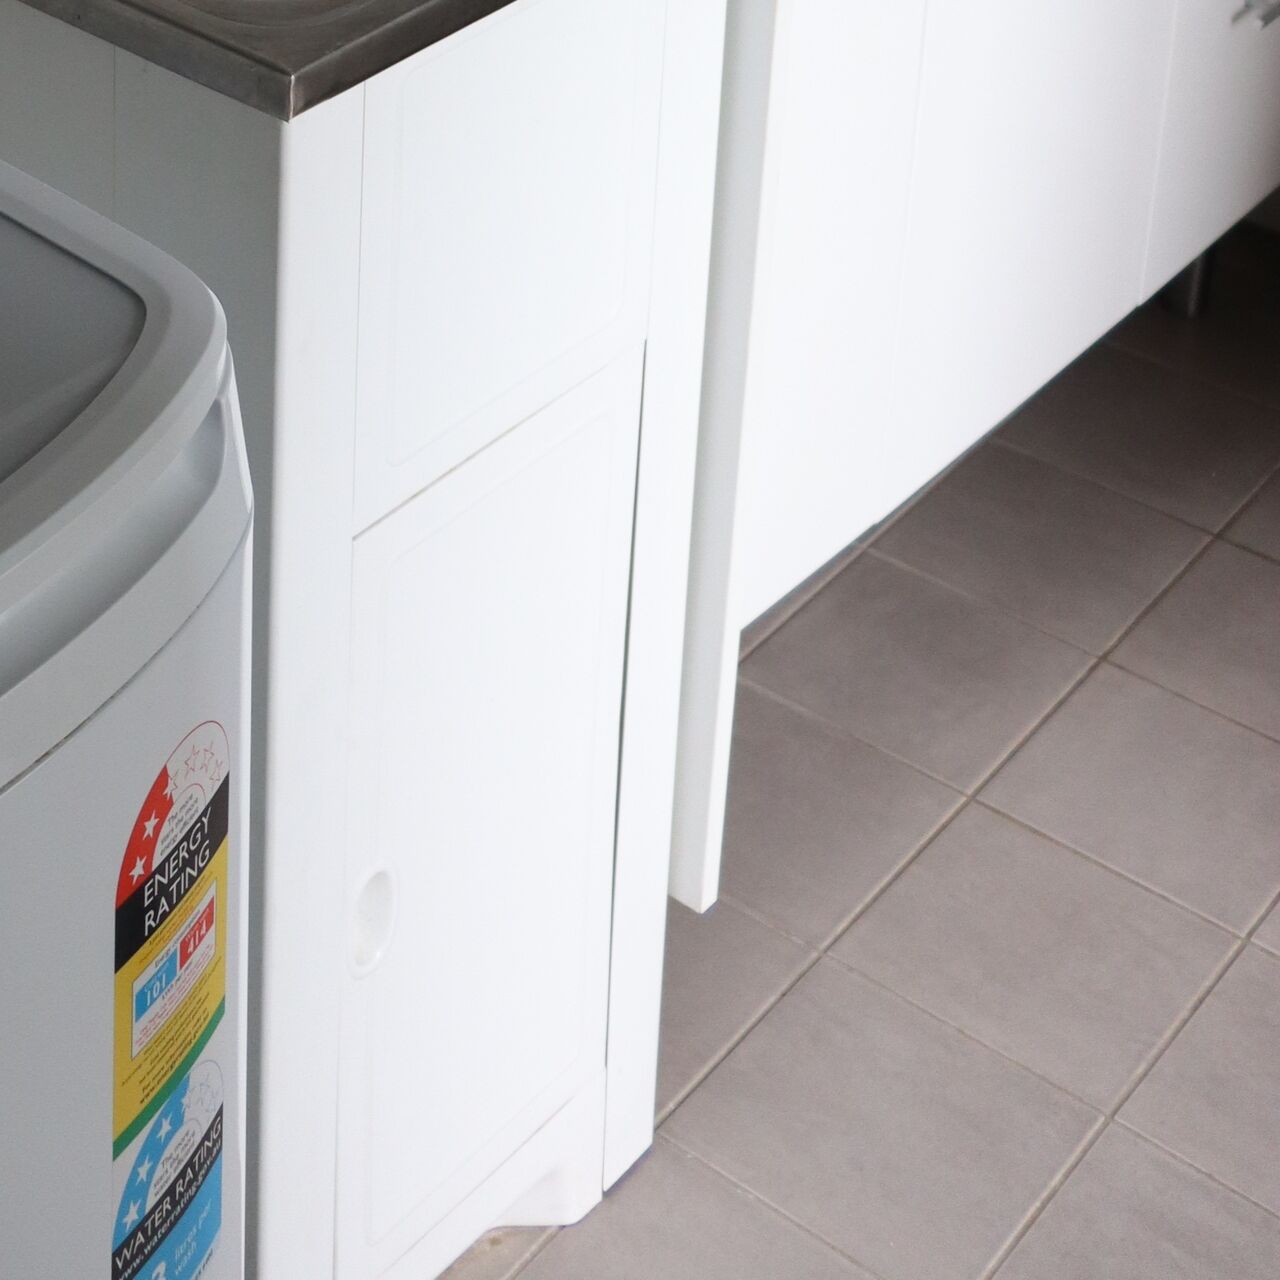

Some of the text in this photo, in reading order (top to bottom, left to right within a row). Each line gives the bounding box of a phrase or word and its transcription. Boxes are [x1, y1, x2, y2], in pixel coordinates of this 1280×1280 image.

[144, 807, 211, 907] ENERGY
[145, 839, 210, 936] RATING
[188, 919, 207, 954] 414
[146, 973, 165, 1006] 101
[115, 1197, 172, 1270] WATER
[176, 1116, 221, 1201] RATING
